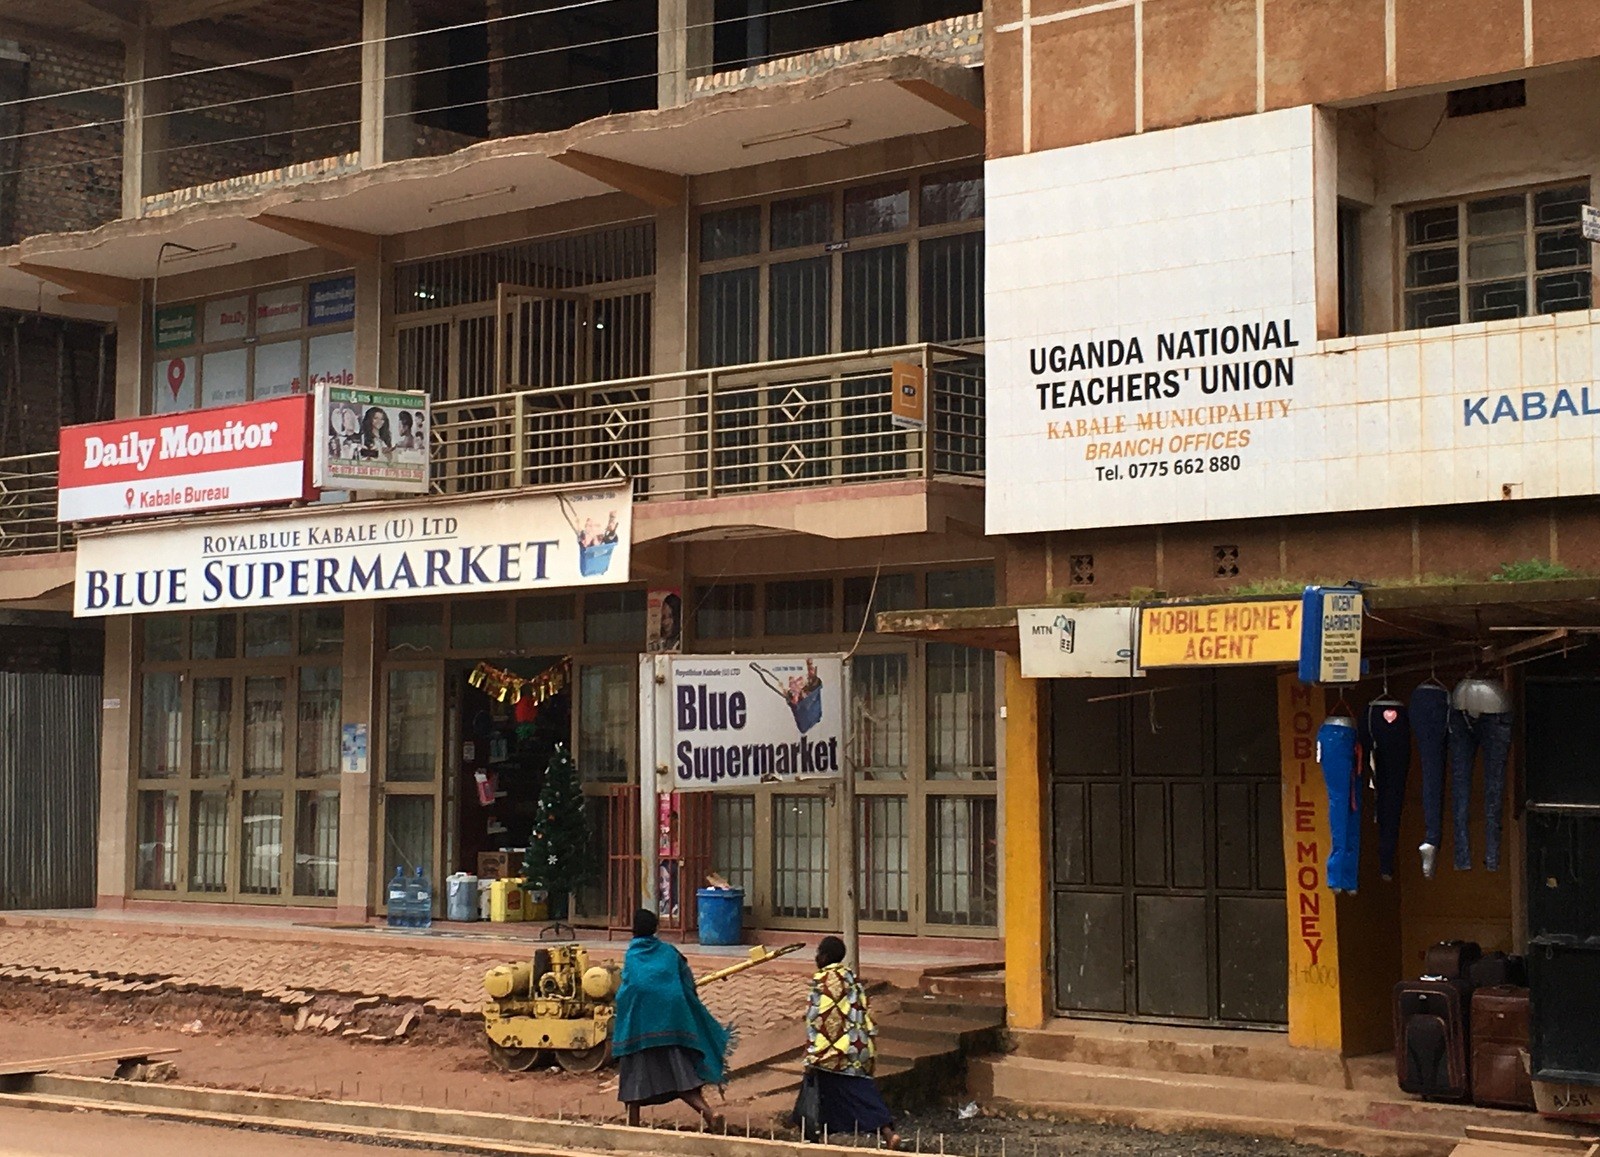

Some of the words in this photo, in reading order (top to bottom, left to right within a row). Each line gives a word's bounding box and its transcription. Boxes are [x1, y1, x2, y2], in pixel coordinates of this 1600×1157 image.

[220, 312, 246, 326] Daily
[257, 302, 301, 319] Monitor
[1030, 337, 1144, 376] UGANDA
[1157, 319, 1299, 362] NATIONAL
[1036, 368, 1190, 411] TEACHERS'
[1200, 357, 1294, 395] UNION
[1046, 414, 1127, 440] KABALE
[1137, 398, 1293, 431] MUNICIPALITY
[1464, 386, 1600, 427] KABAL
[84, 431, 156, 471] Daily
[159, 420, 278, 460] Monitor
[1085, 437, 1163, 461] BRANCH
[1169, 429, 1251, 454] OFFICES
[1096, 465, 1124, 482] Tel.
[1129, 461, 1168, 480] 0775
[1174, 458, 1204, 476] 662
[1209, 455, 1241, 472] 880
[140, 488, 182, 508] Kabale
[184, 486, 230, 504] Bureau
[203, 530, 301, 554] ROYALBLUE
[308, 524, 378, 546] KABALE
[384, 520, 414, 542] (U)
[422, 516, 458, 537] LTD
[84, 568, 188, 611] BLUE
[202, 540, 560, 603] SUPERMARKET
[1032, 625, 1053, 636] MTN
[1149, 608, 1219, 635] MOBILE
[1183, 634, 1259, 660] AGENT
[677, 684, 747, 731] Blue
[677, 735, 838, 783] Supermarket
[1291, 684, 1316, 832] MOBILE
[1296, 841, 1323, 965] MONEY
